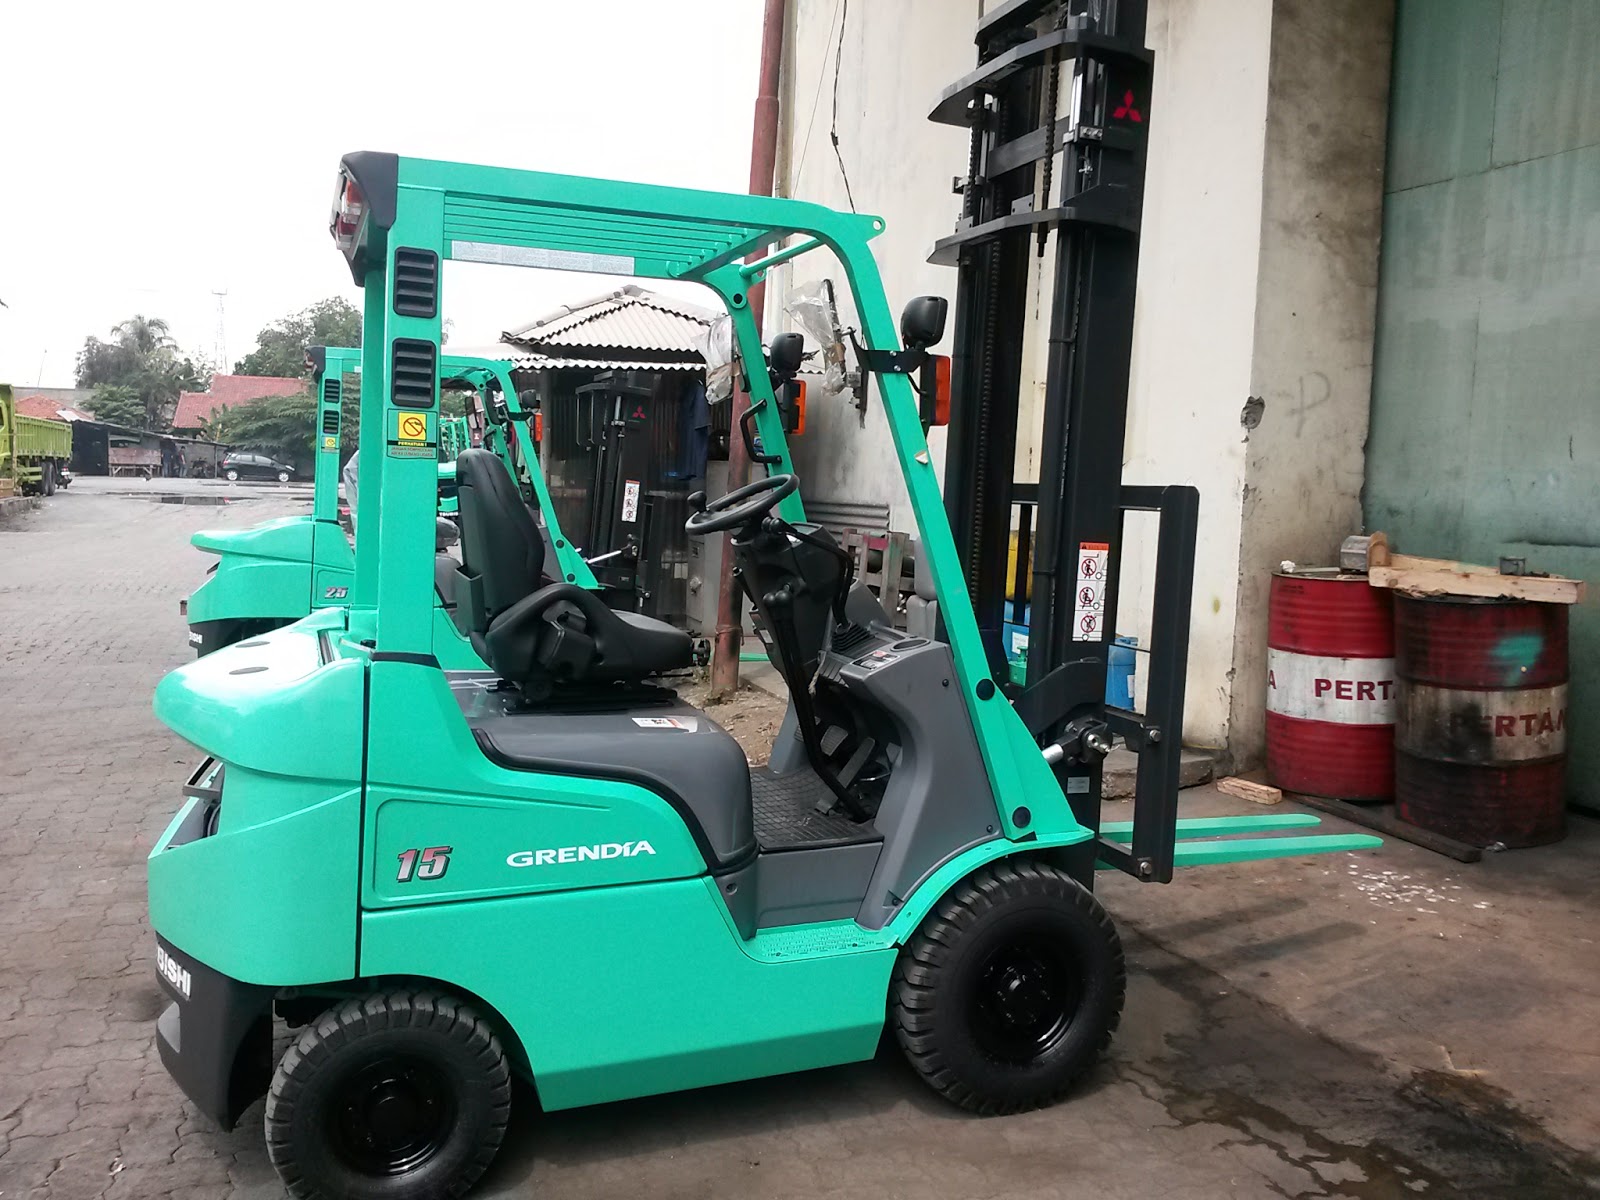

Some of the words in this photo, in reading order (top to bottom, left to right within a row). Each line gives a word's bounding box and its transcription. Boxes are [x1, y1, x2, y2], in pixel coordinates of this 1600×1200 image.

[325, 586, 349, 599] 25
[1314, 678, 1396, 701] PERT
[396, 846, 453, 883] 15
[506, 840, 656, 868] GRENDIA
